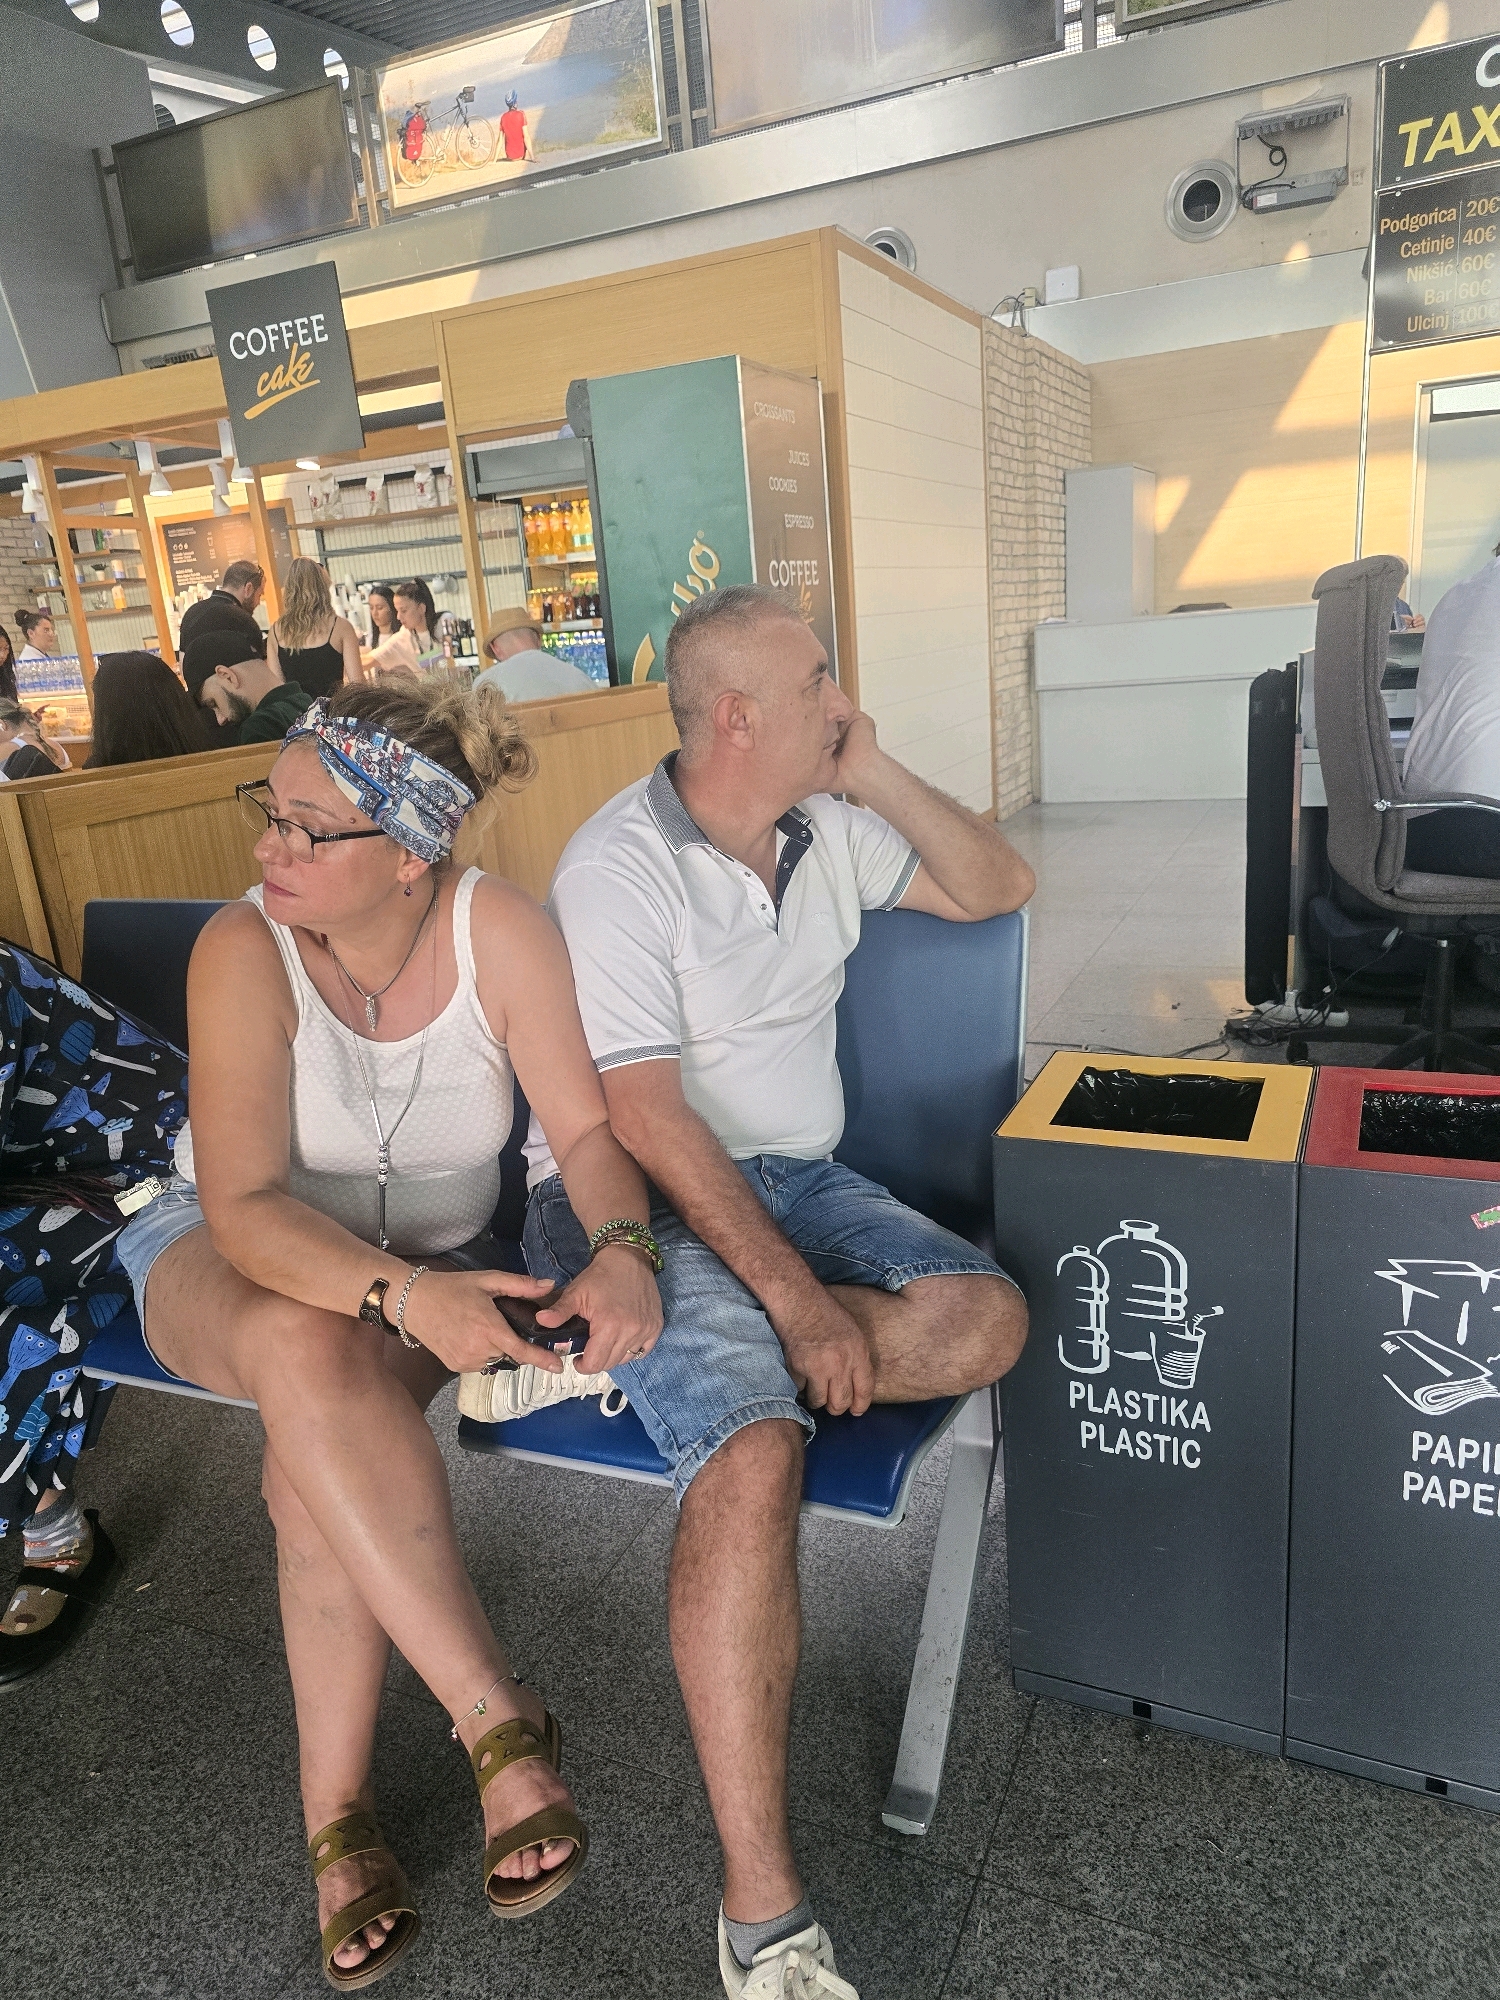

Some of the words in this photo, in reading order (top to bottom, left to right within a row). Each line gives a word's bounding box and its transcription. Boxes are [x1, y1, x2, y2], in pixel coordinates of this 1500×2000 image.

[1398, 103, 1500, 168] TAX
[1380, 206, 1457, 236] Podgorica
[1465, 196, 1500, 218] 20€
[1400, 234, 1455, 259] Cetinje
[1462, 225, 1497, 246] 40€
[1406, 259, 1454, 284] Nikšić
[1461, 252, 1496, 274] 60€
[1424, 288, 1453, 306] Bar
[1459, 278, 1492, 300] 60€
[1407, 311, 1450, 333] Ulcinj
[1459, 303, 1500, 324] 100€
[229, 313, 329, 360] COFFEE
[256, 342, 315, 398] cake
[753, 401, 796, 424] CROISSANTS
[788, 449, 810, 467] JUICES
[768, 476, 798, 494] COOKIES
[784, 513, 815, 530] ESPRESSO
[768, 559, 820, 588] COFFEE
[1069, 1380, 1211, 1433] PLASTIKA
[1080, 1420, 1201, 1469] PLASTIC
[1402, 1470, 1500, 1518] PAPE
